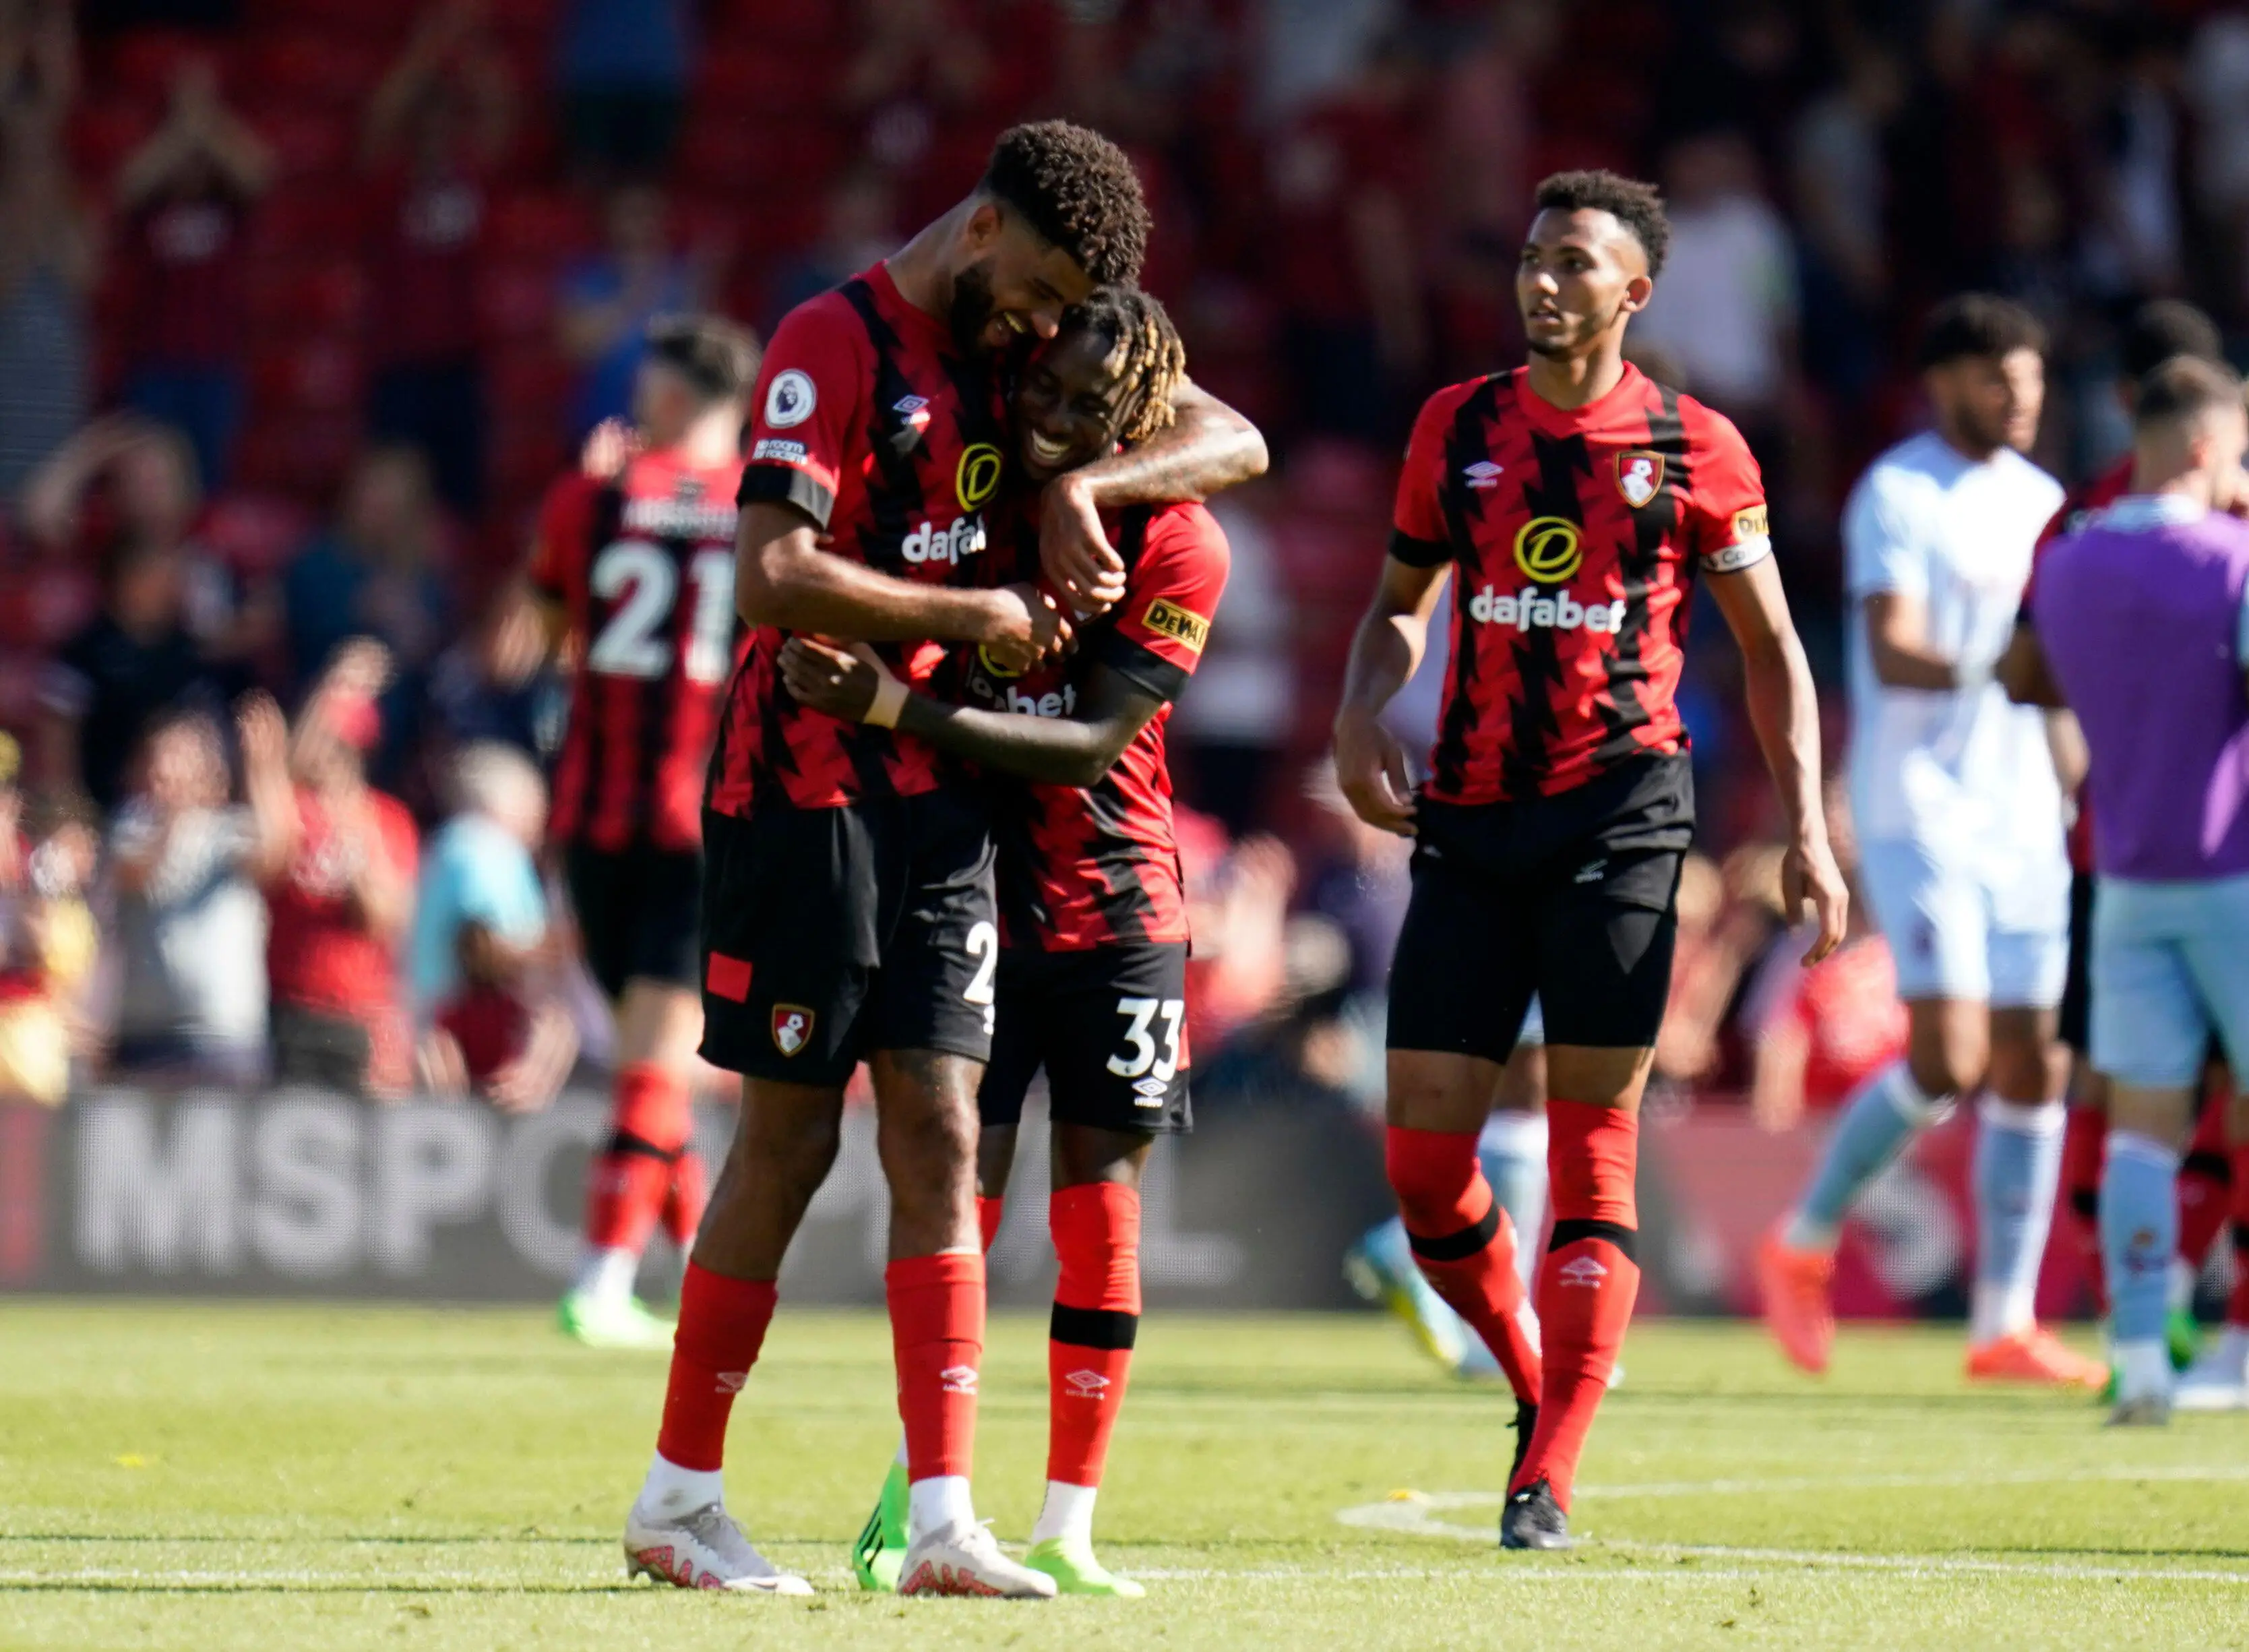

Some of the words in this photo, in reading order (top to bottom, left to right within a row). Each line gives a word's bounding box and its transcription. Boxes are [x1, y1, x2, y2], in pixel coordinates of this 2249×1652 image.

[588, 537, 737, 686] 21
[1469, 584, 1627, 634] dafabet
[1106, 997, 1184, 1082] 33
